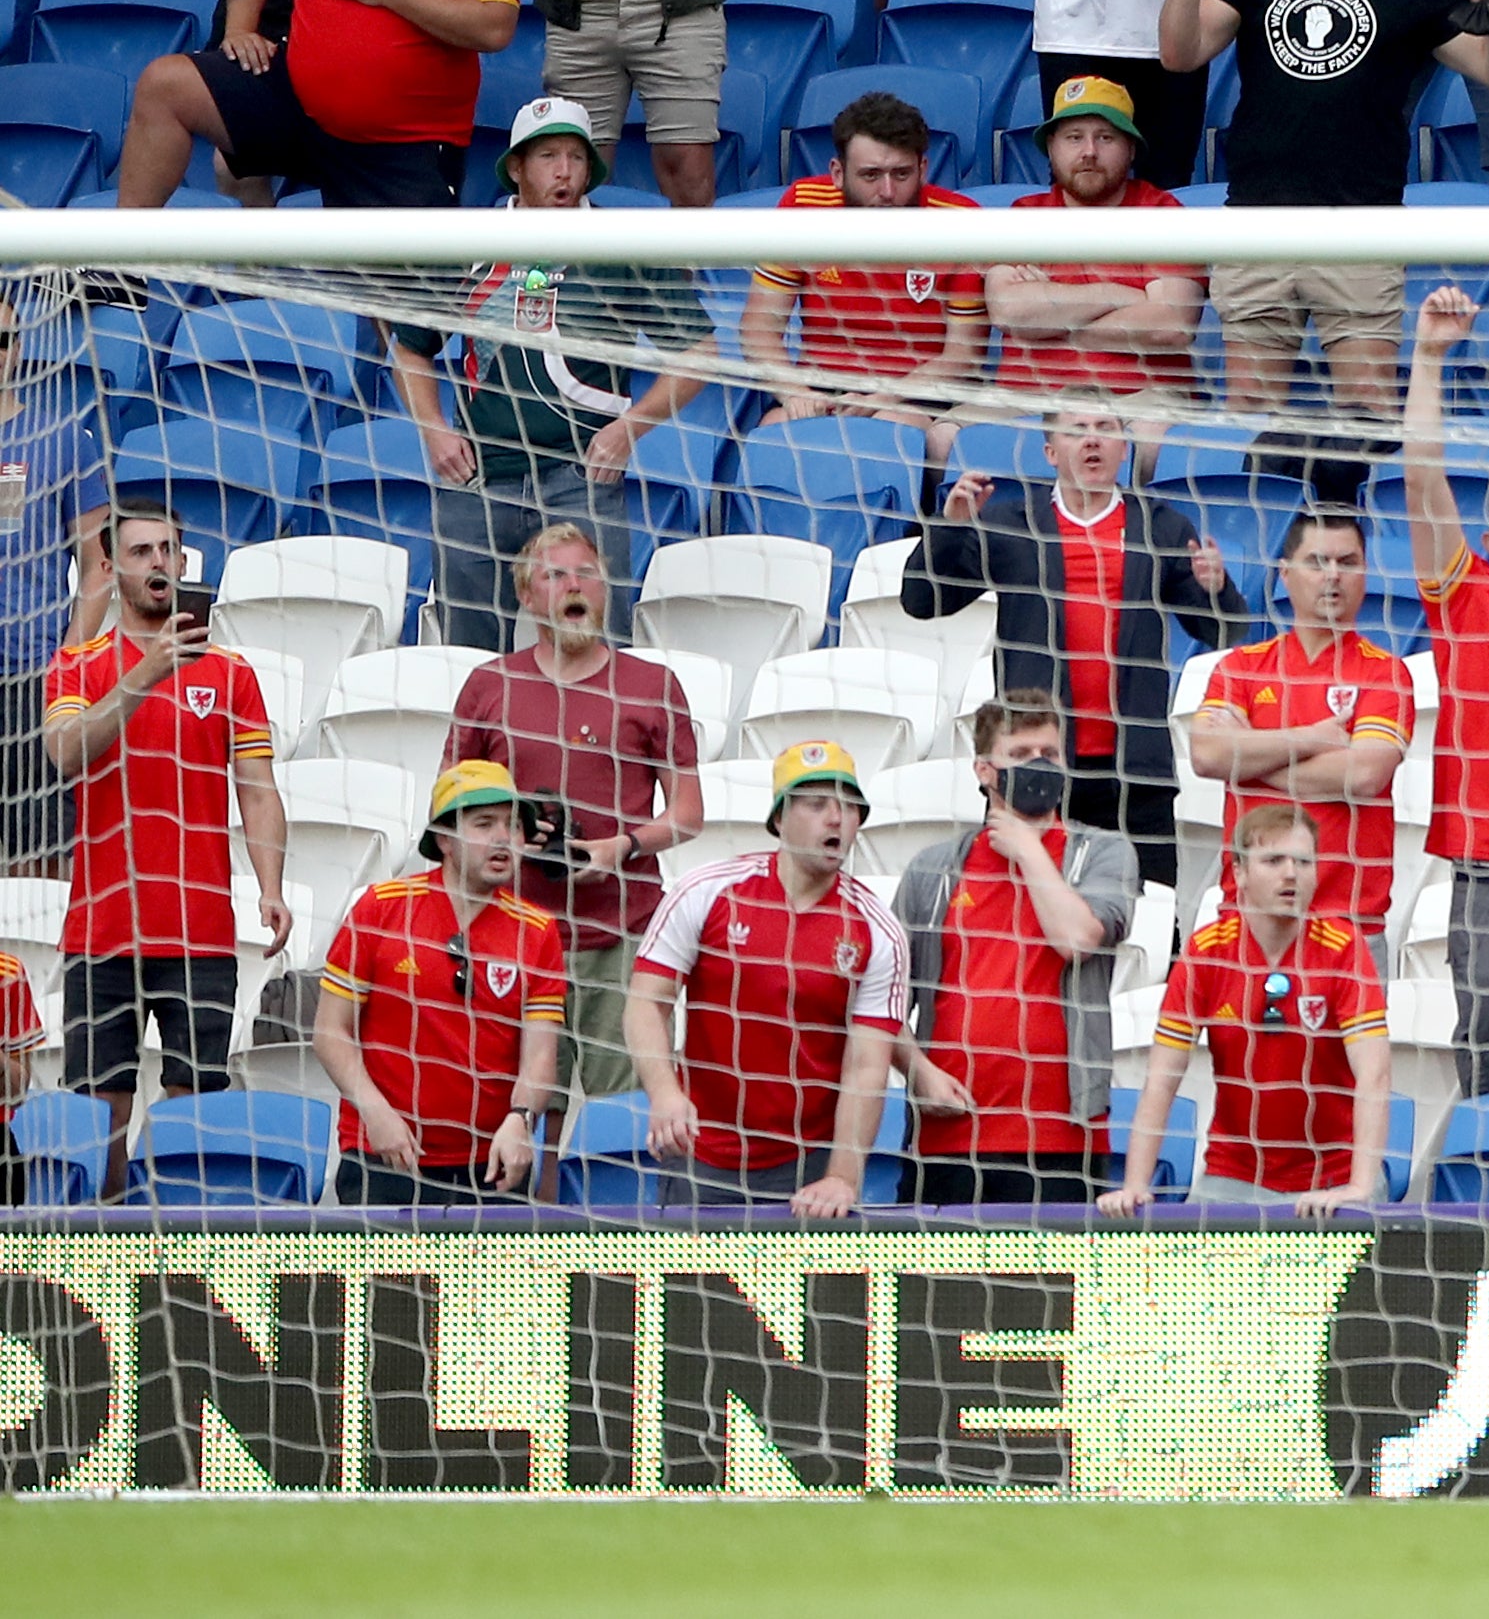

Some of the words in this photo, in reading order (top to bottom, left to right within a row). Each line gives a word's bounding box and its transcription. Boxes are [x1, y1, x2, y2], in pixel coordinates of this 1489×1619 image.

[1274, 39, 1300, 68] KEEP
[1301, 61, 1327, 74] THE
[1328, 43, 1362, 71] FAITH
